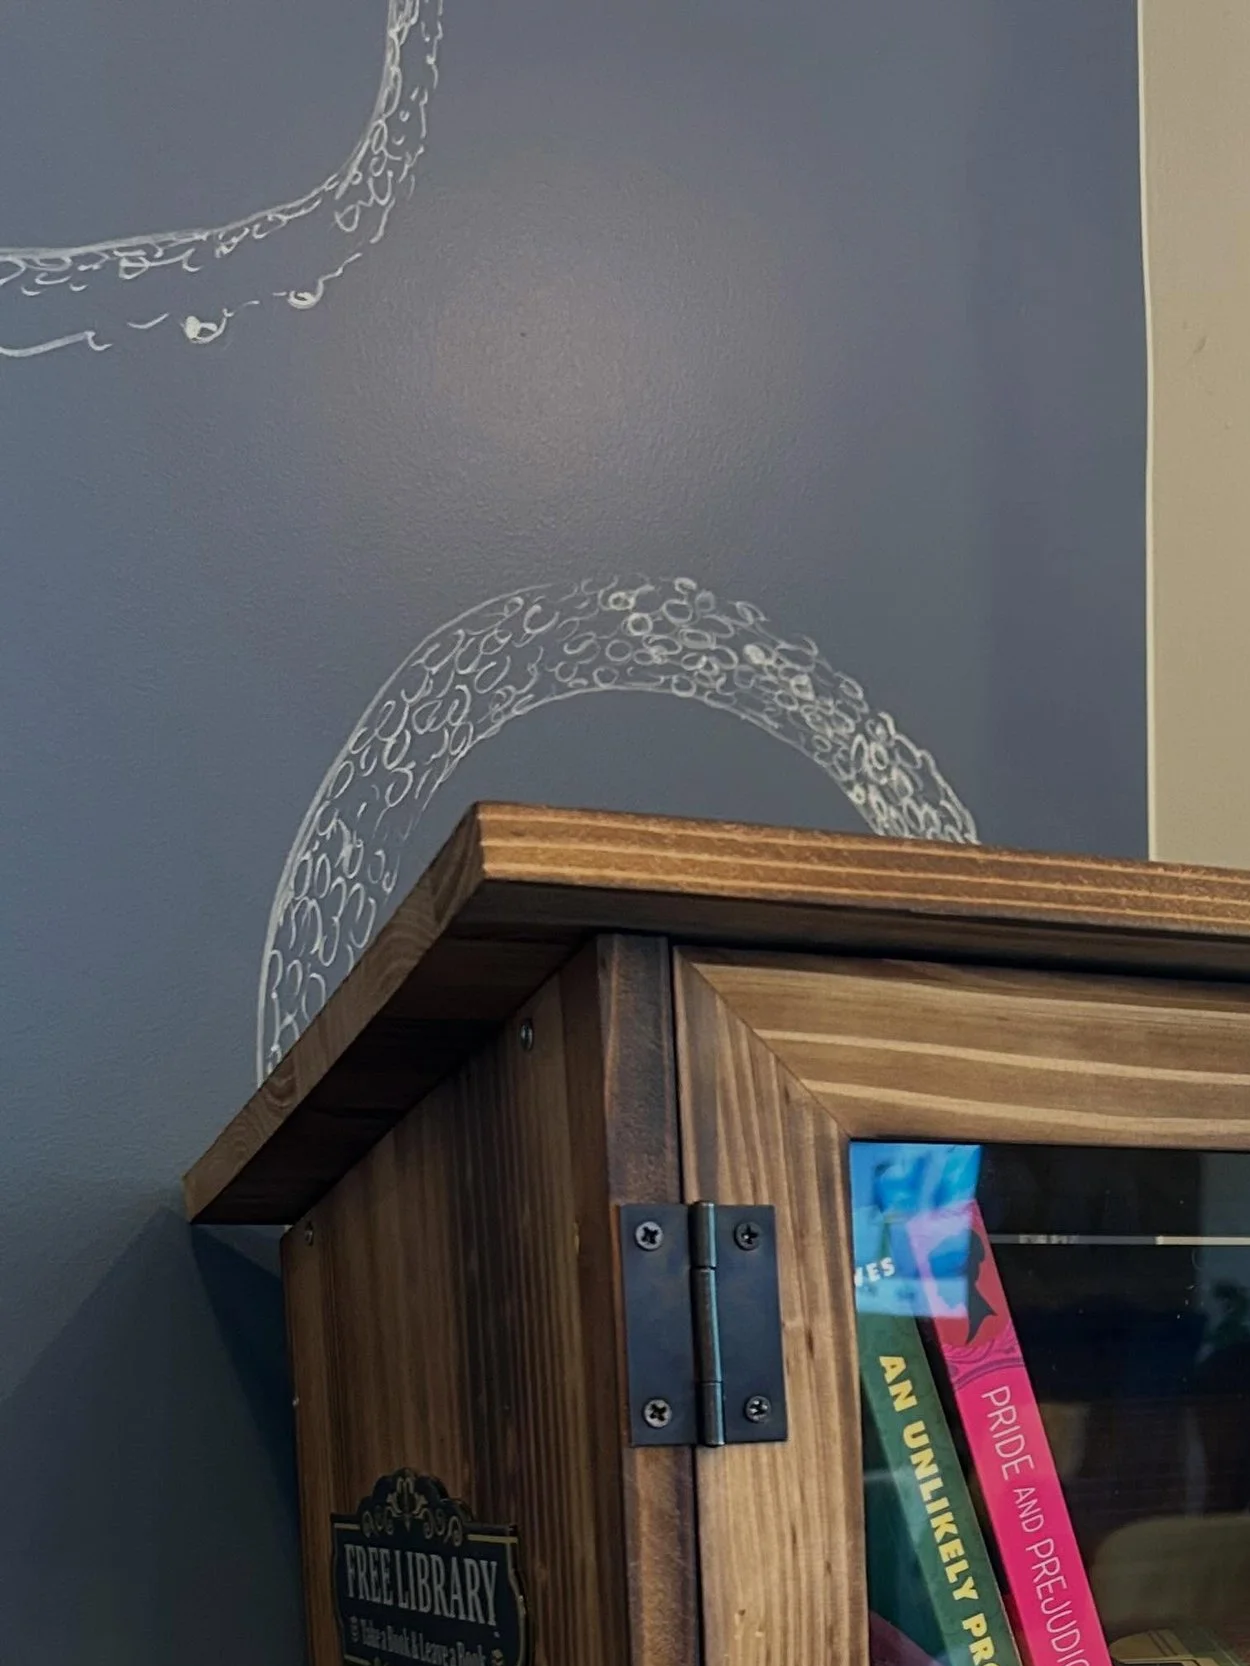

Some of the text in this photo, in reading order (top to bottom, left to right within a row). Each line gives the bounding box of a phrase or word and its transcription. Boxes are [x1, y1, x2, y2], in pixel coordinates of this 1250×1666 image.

[878, 1354, 919, 1412] AN
[902, 1420, 980, 1602] UNLIKELY
[981, 1385, 1035, 1482] PRIDE
[1013, 1486, 1045, 1534] AND
[344, 1543, 498, 1627] FREE LIBRARY
